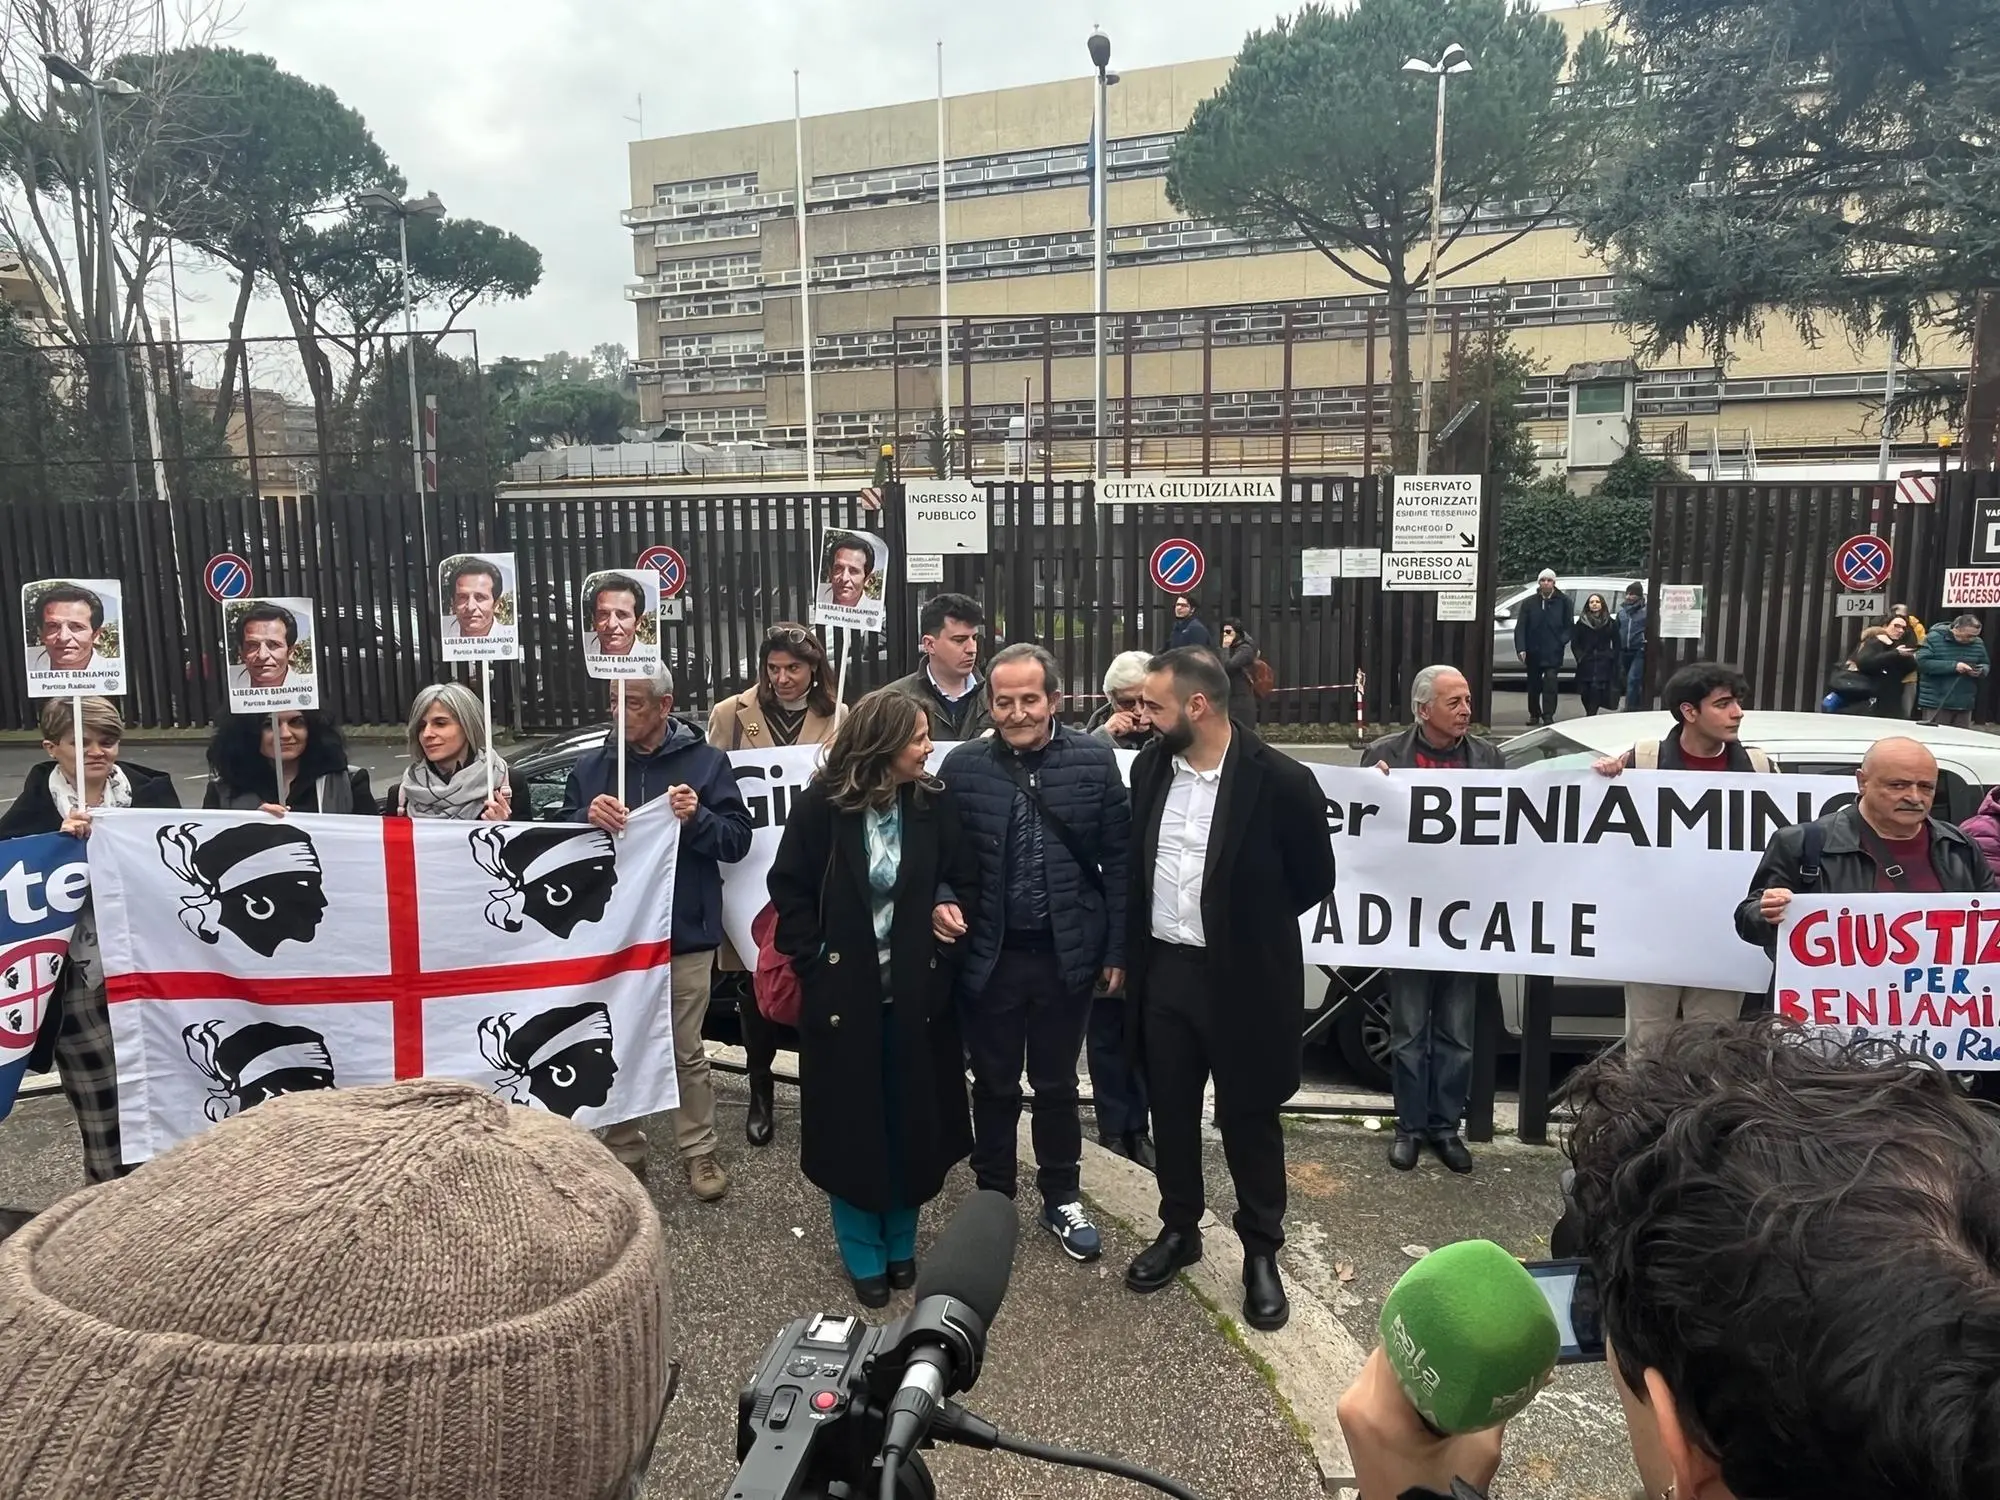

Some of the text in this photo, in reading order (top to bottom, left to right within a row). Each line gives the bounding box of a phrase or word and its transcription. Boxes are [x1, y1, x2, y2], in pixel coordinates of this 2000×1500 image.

[1159, 482, 1276, 498] GIUDIZIARIA
[1403, 481, 1472, 491] RISERVATO
[908, 493, 985, 504] INGRESSO AL
[1396, 496, 1478, 506] AUTORIZZATI
[917, 510, 977, 521] PUBBLICO
[1430, 509, 1478, 517] TESSERINO
[1445, 523, 1454, 532] D
[1387, 557, 1453, 568] INGRESSO
[1456, 557, 1473, 568] AL
[1396, 570, 1463, 581] PUBBLICO
[586, 655, 657, 664] LIBERATE BENIAMINO
[30, 670, 121, 680] LIBERATE BENIAMINO
[232, 685, 314, 697] LIBERATE BENIAMINO
[1904, 966, 1972, 995] PER
